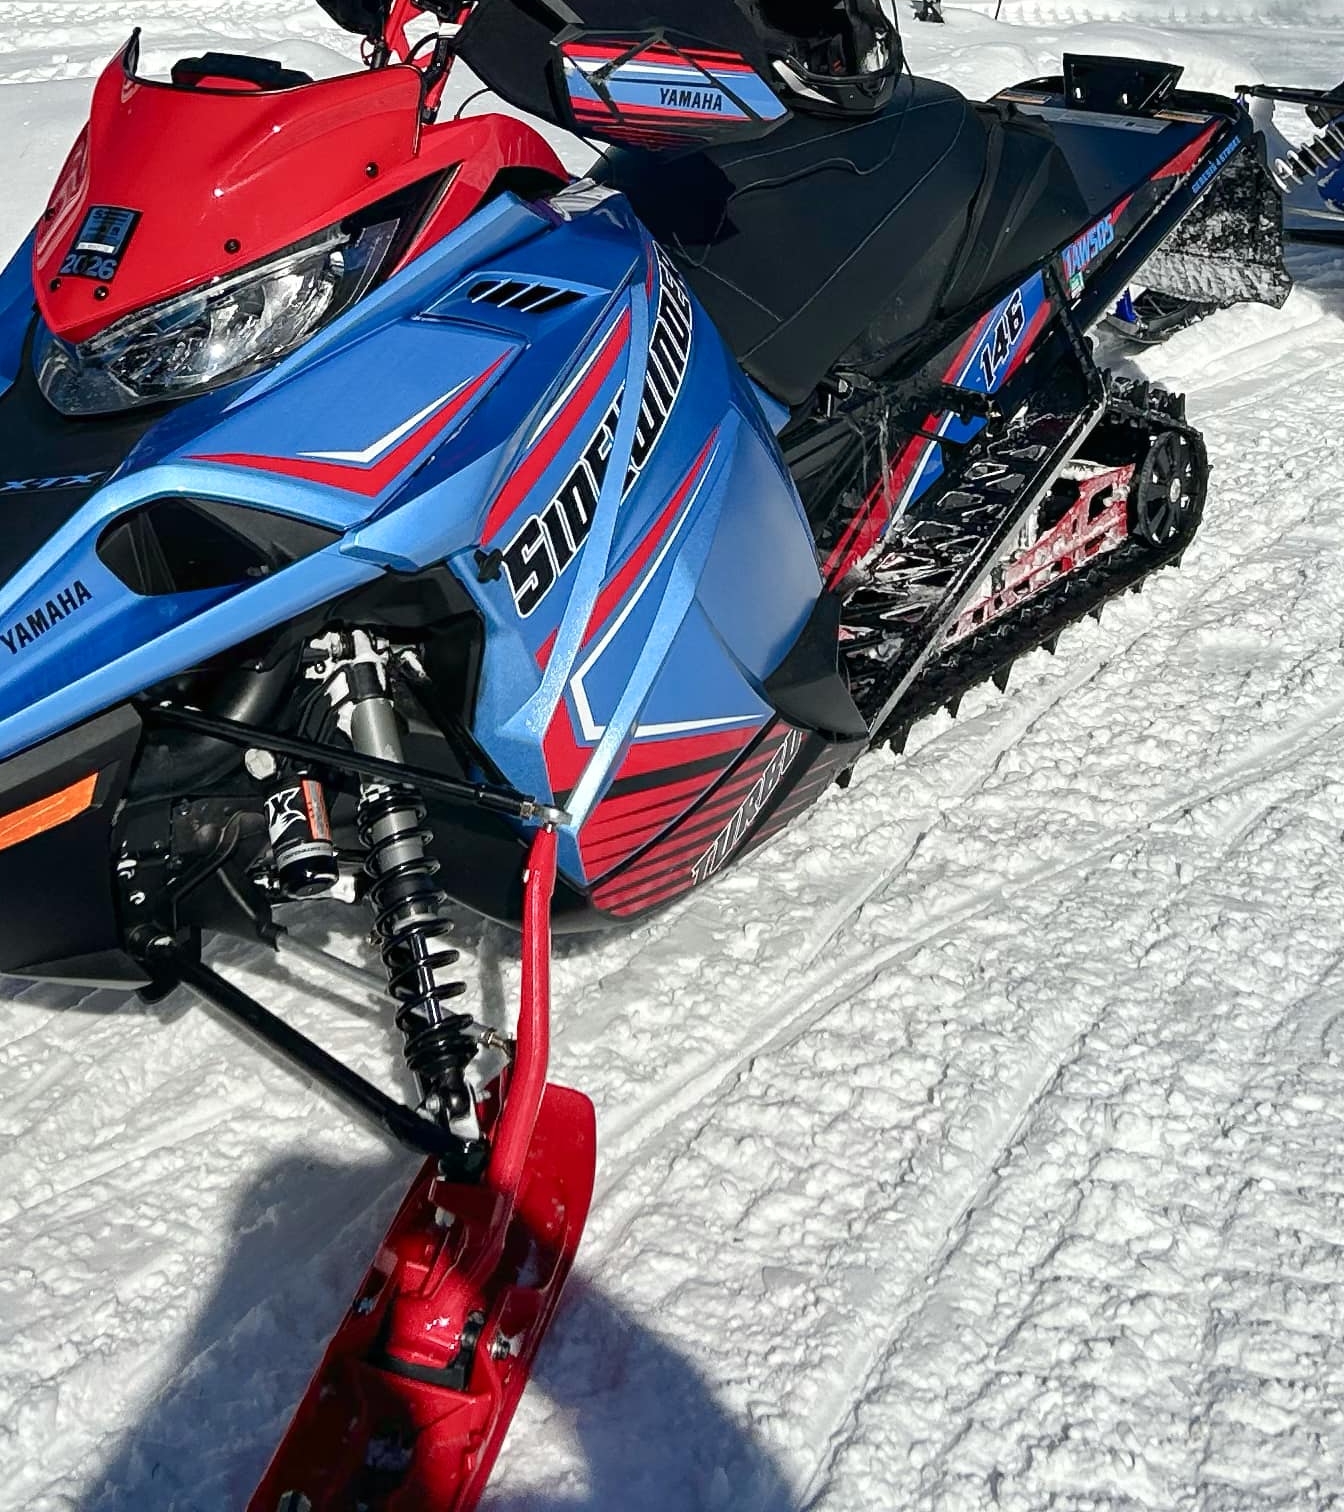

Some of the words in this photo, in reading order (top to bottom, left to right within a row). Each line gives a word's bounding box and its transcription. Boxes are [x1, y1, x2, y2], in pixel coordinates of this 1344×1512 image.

[660, 87, 722, 112] YAMAHA
[59, 254, 118, 280] 2026
[980, 287, 1026, 392] 146
[0, 579, 93, 655] YAMAHA
